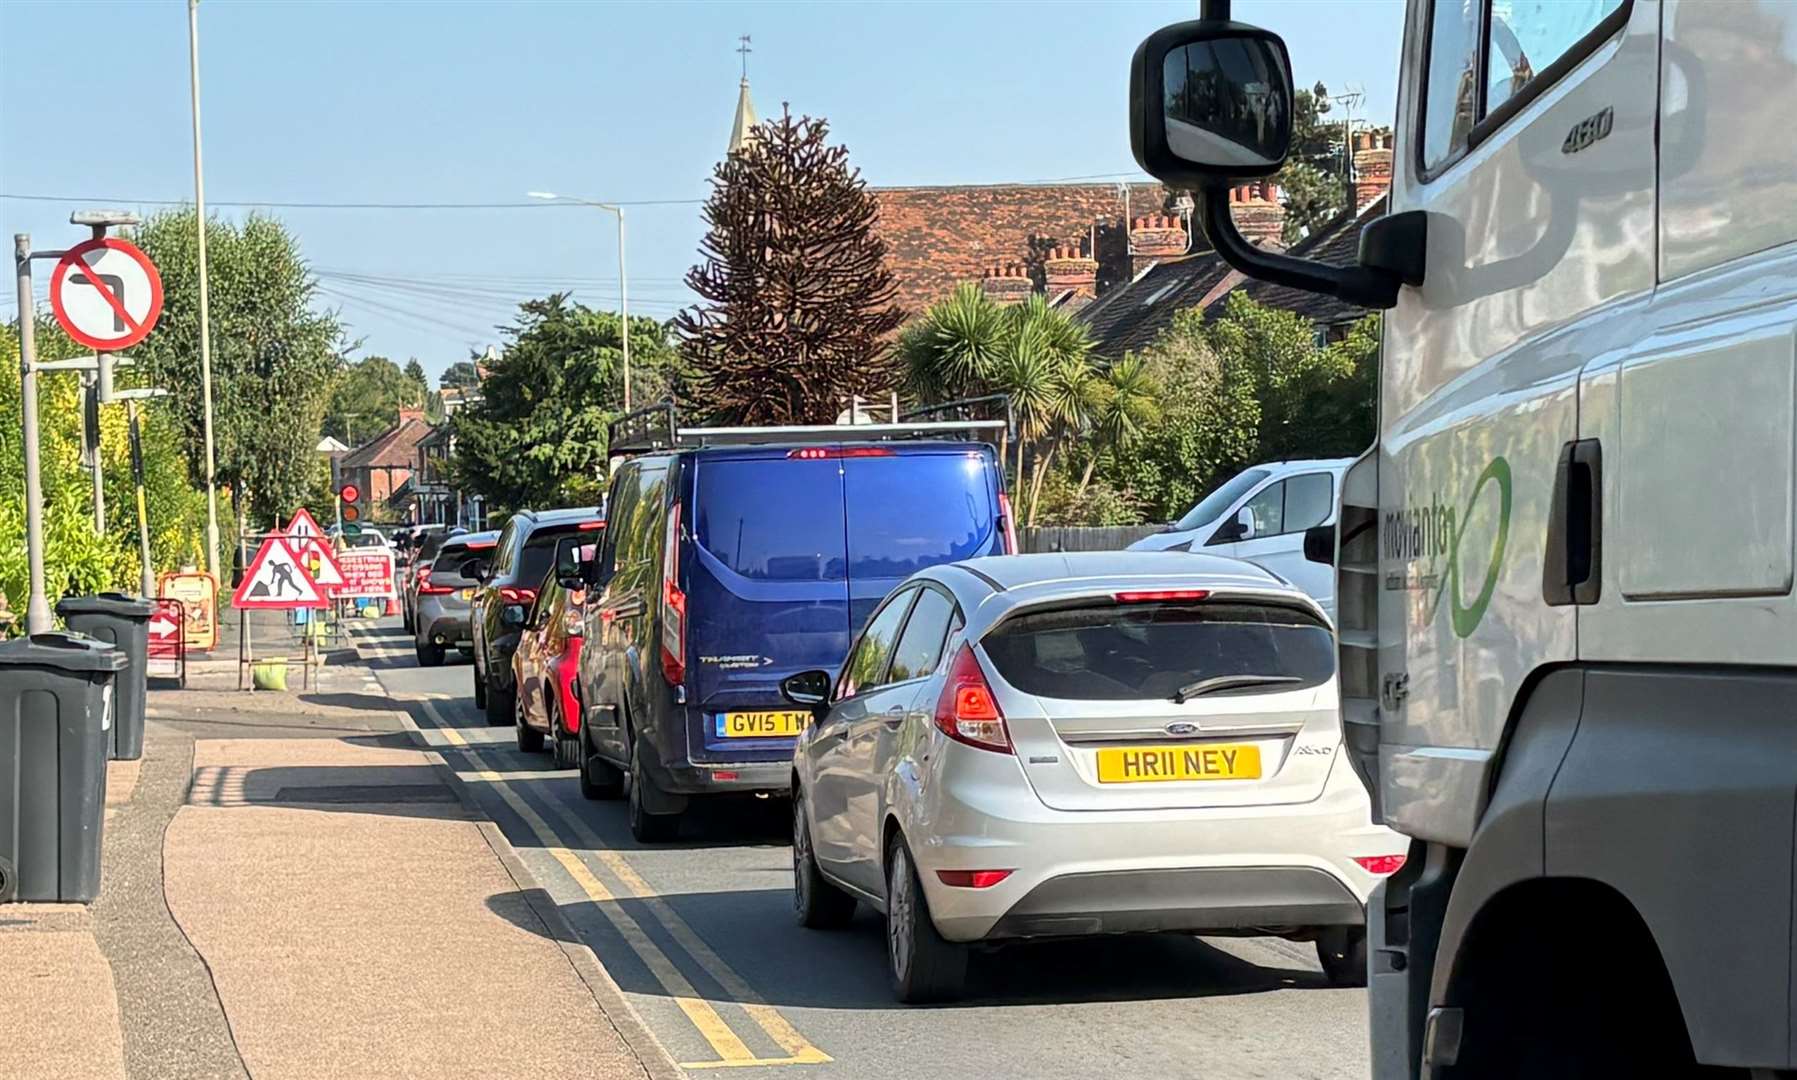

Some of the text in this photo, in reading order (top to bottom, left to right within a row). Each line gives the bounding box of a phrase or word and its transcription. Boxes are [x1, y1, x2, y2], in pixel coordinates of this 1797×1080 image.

[733, 714, 775, 731] GV15
[1123, 750, 1237, 776] HR11 NEY
